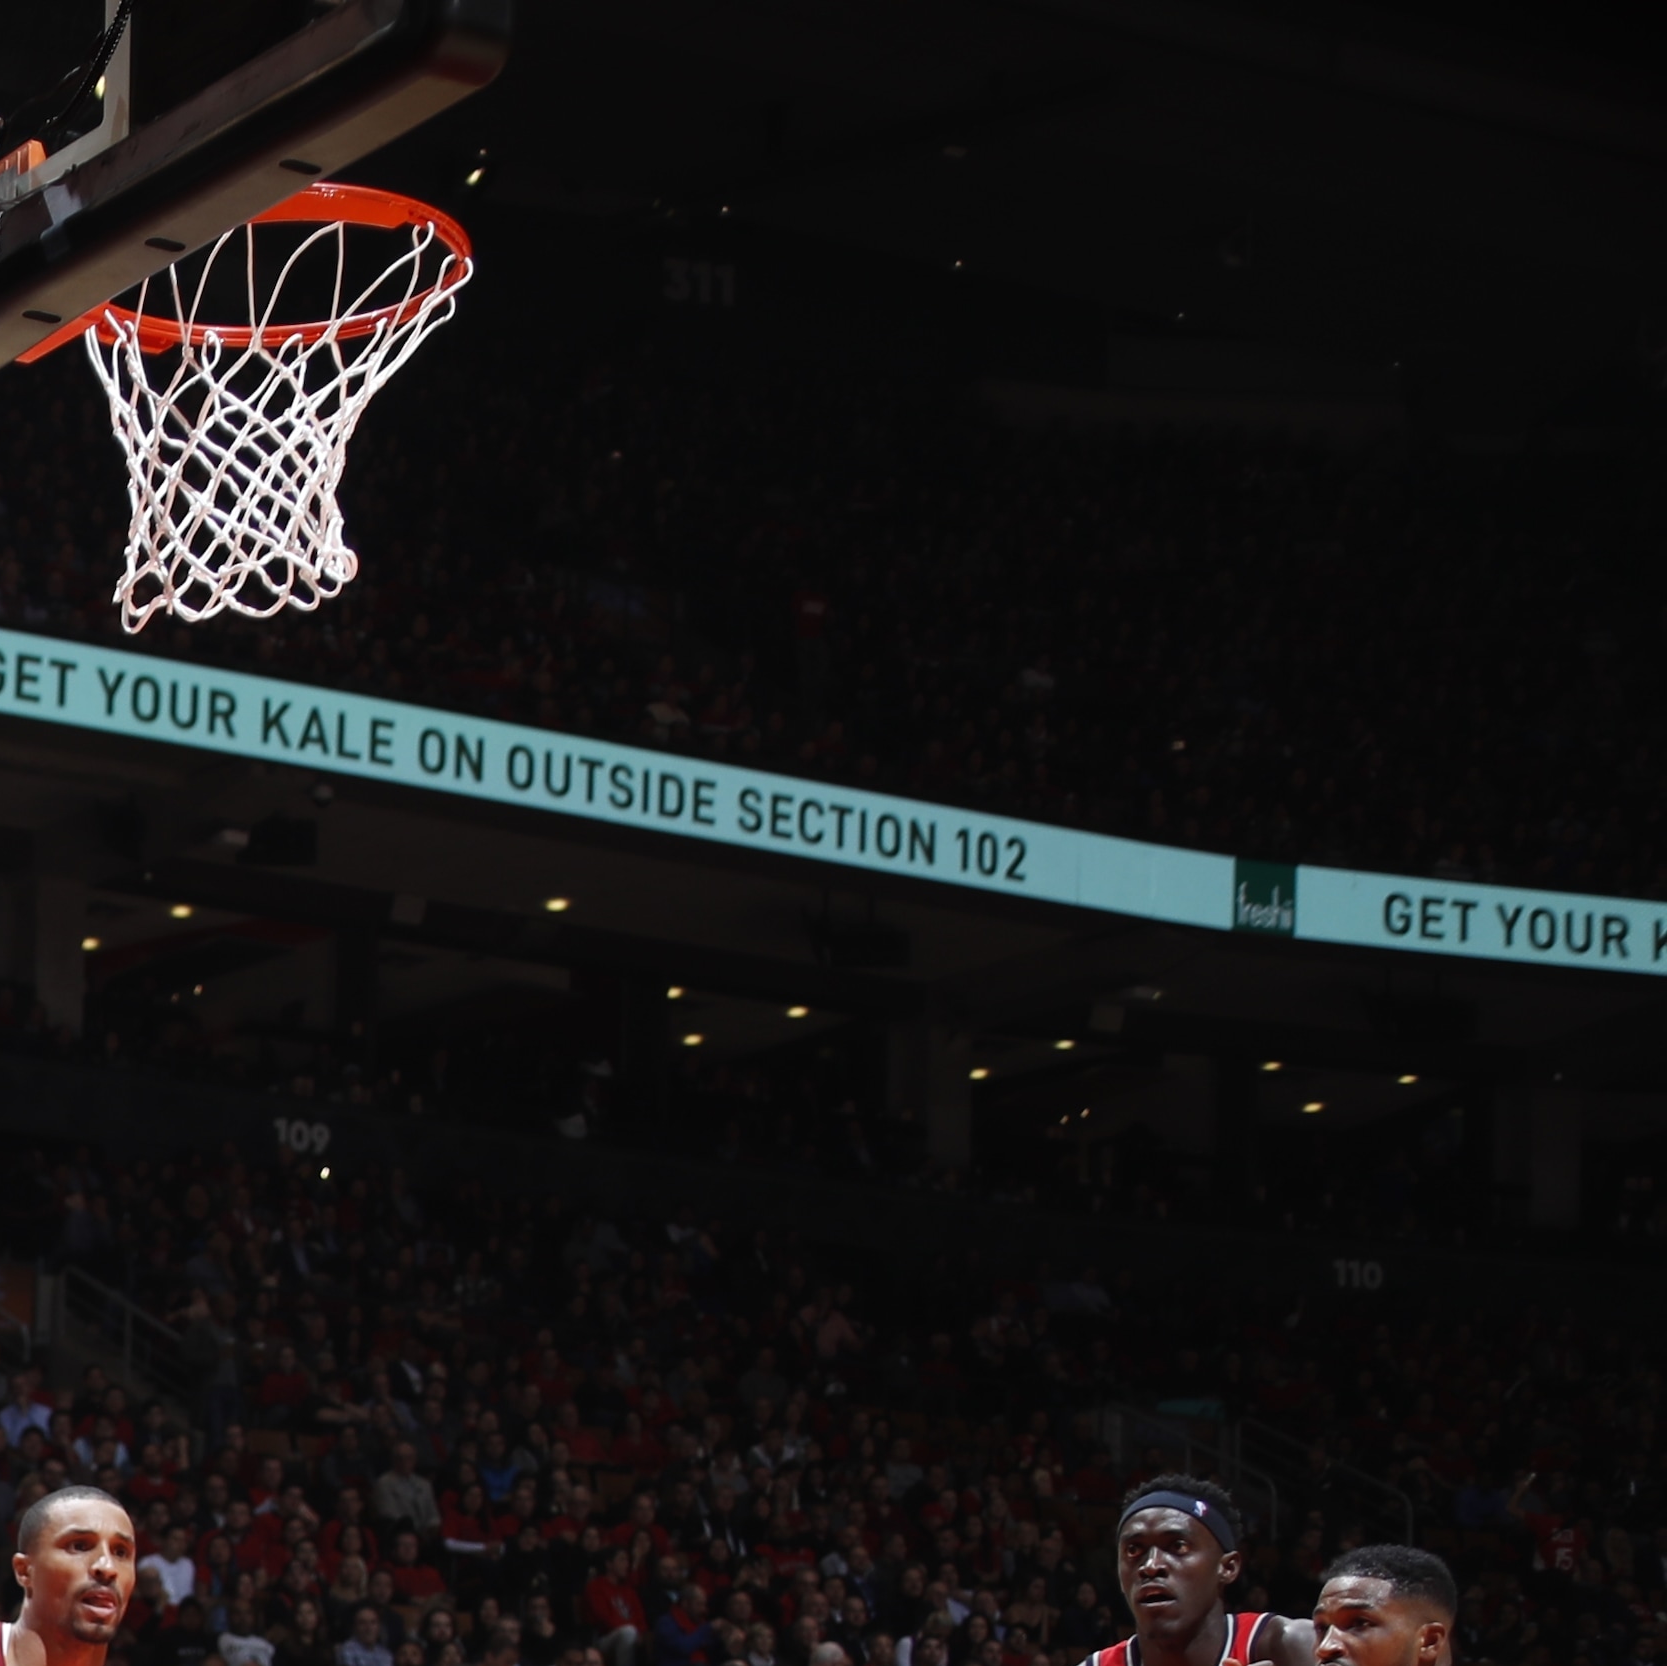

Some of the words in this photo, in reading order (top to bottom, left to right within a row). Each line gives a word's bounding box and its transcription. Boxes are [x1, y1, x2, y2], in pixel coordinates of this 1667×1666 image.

[97, 668, 238, 738] YOUR
[261, 699, 395, 767] KALE
[417, 728, 485, 783] ON
[506, 745, 717, 827] OUTSIDE
[737, 787, 937, 867] SECTION
[955, 828, 1028, 883] 102
[1382, 892, 1479, 944] GET
[1495, 904, 1631, 960] YOUR
[272, 1116, 331, 1157] 109
[1331, 1257, 1385, 1291] 110
